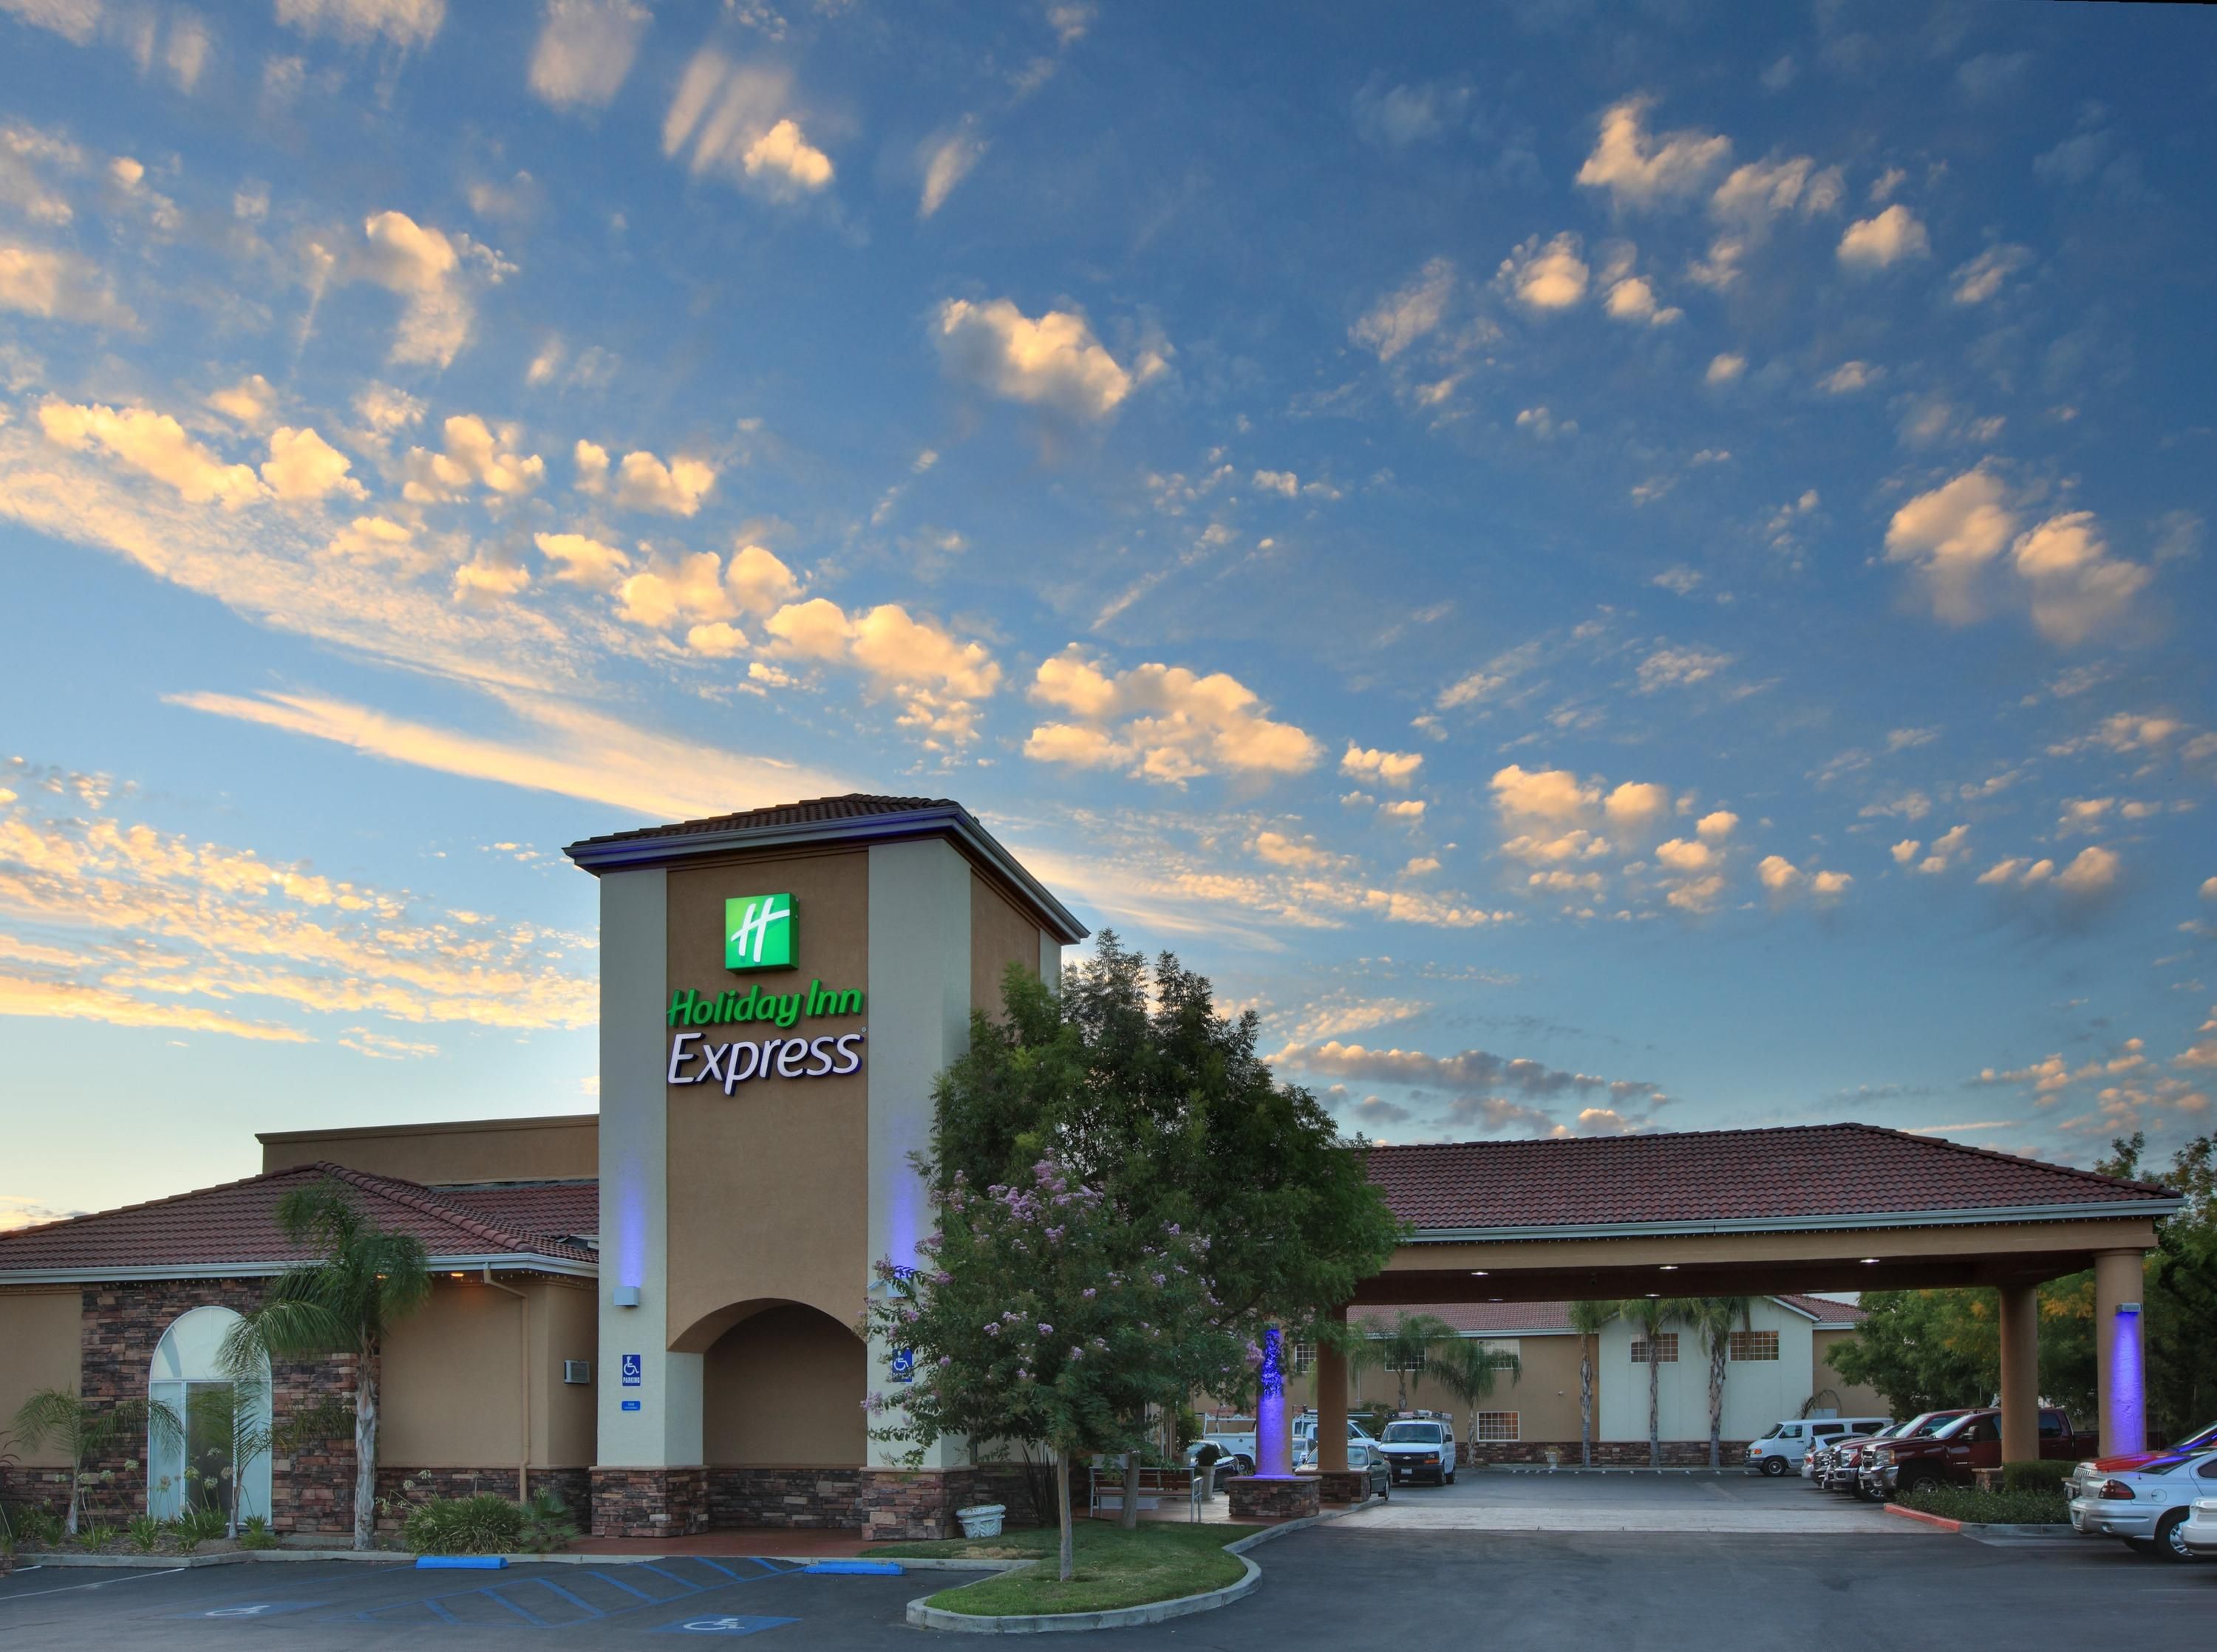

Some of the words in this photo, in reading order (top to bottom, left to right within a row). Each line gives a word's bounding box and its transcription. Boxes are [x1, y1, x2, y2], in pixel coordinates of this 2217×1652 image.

[667, 984, 803, 1028] Holiday
[806, 978, 863, 1017] Inn
[668, 1032, 864, 1096] Express
